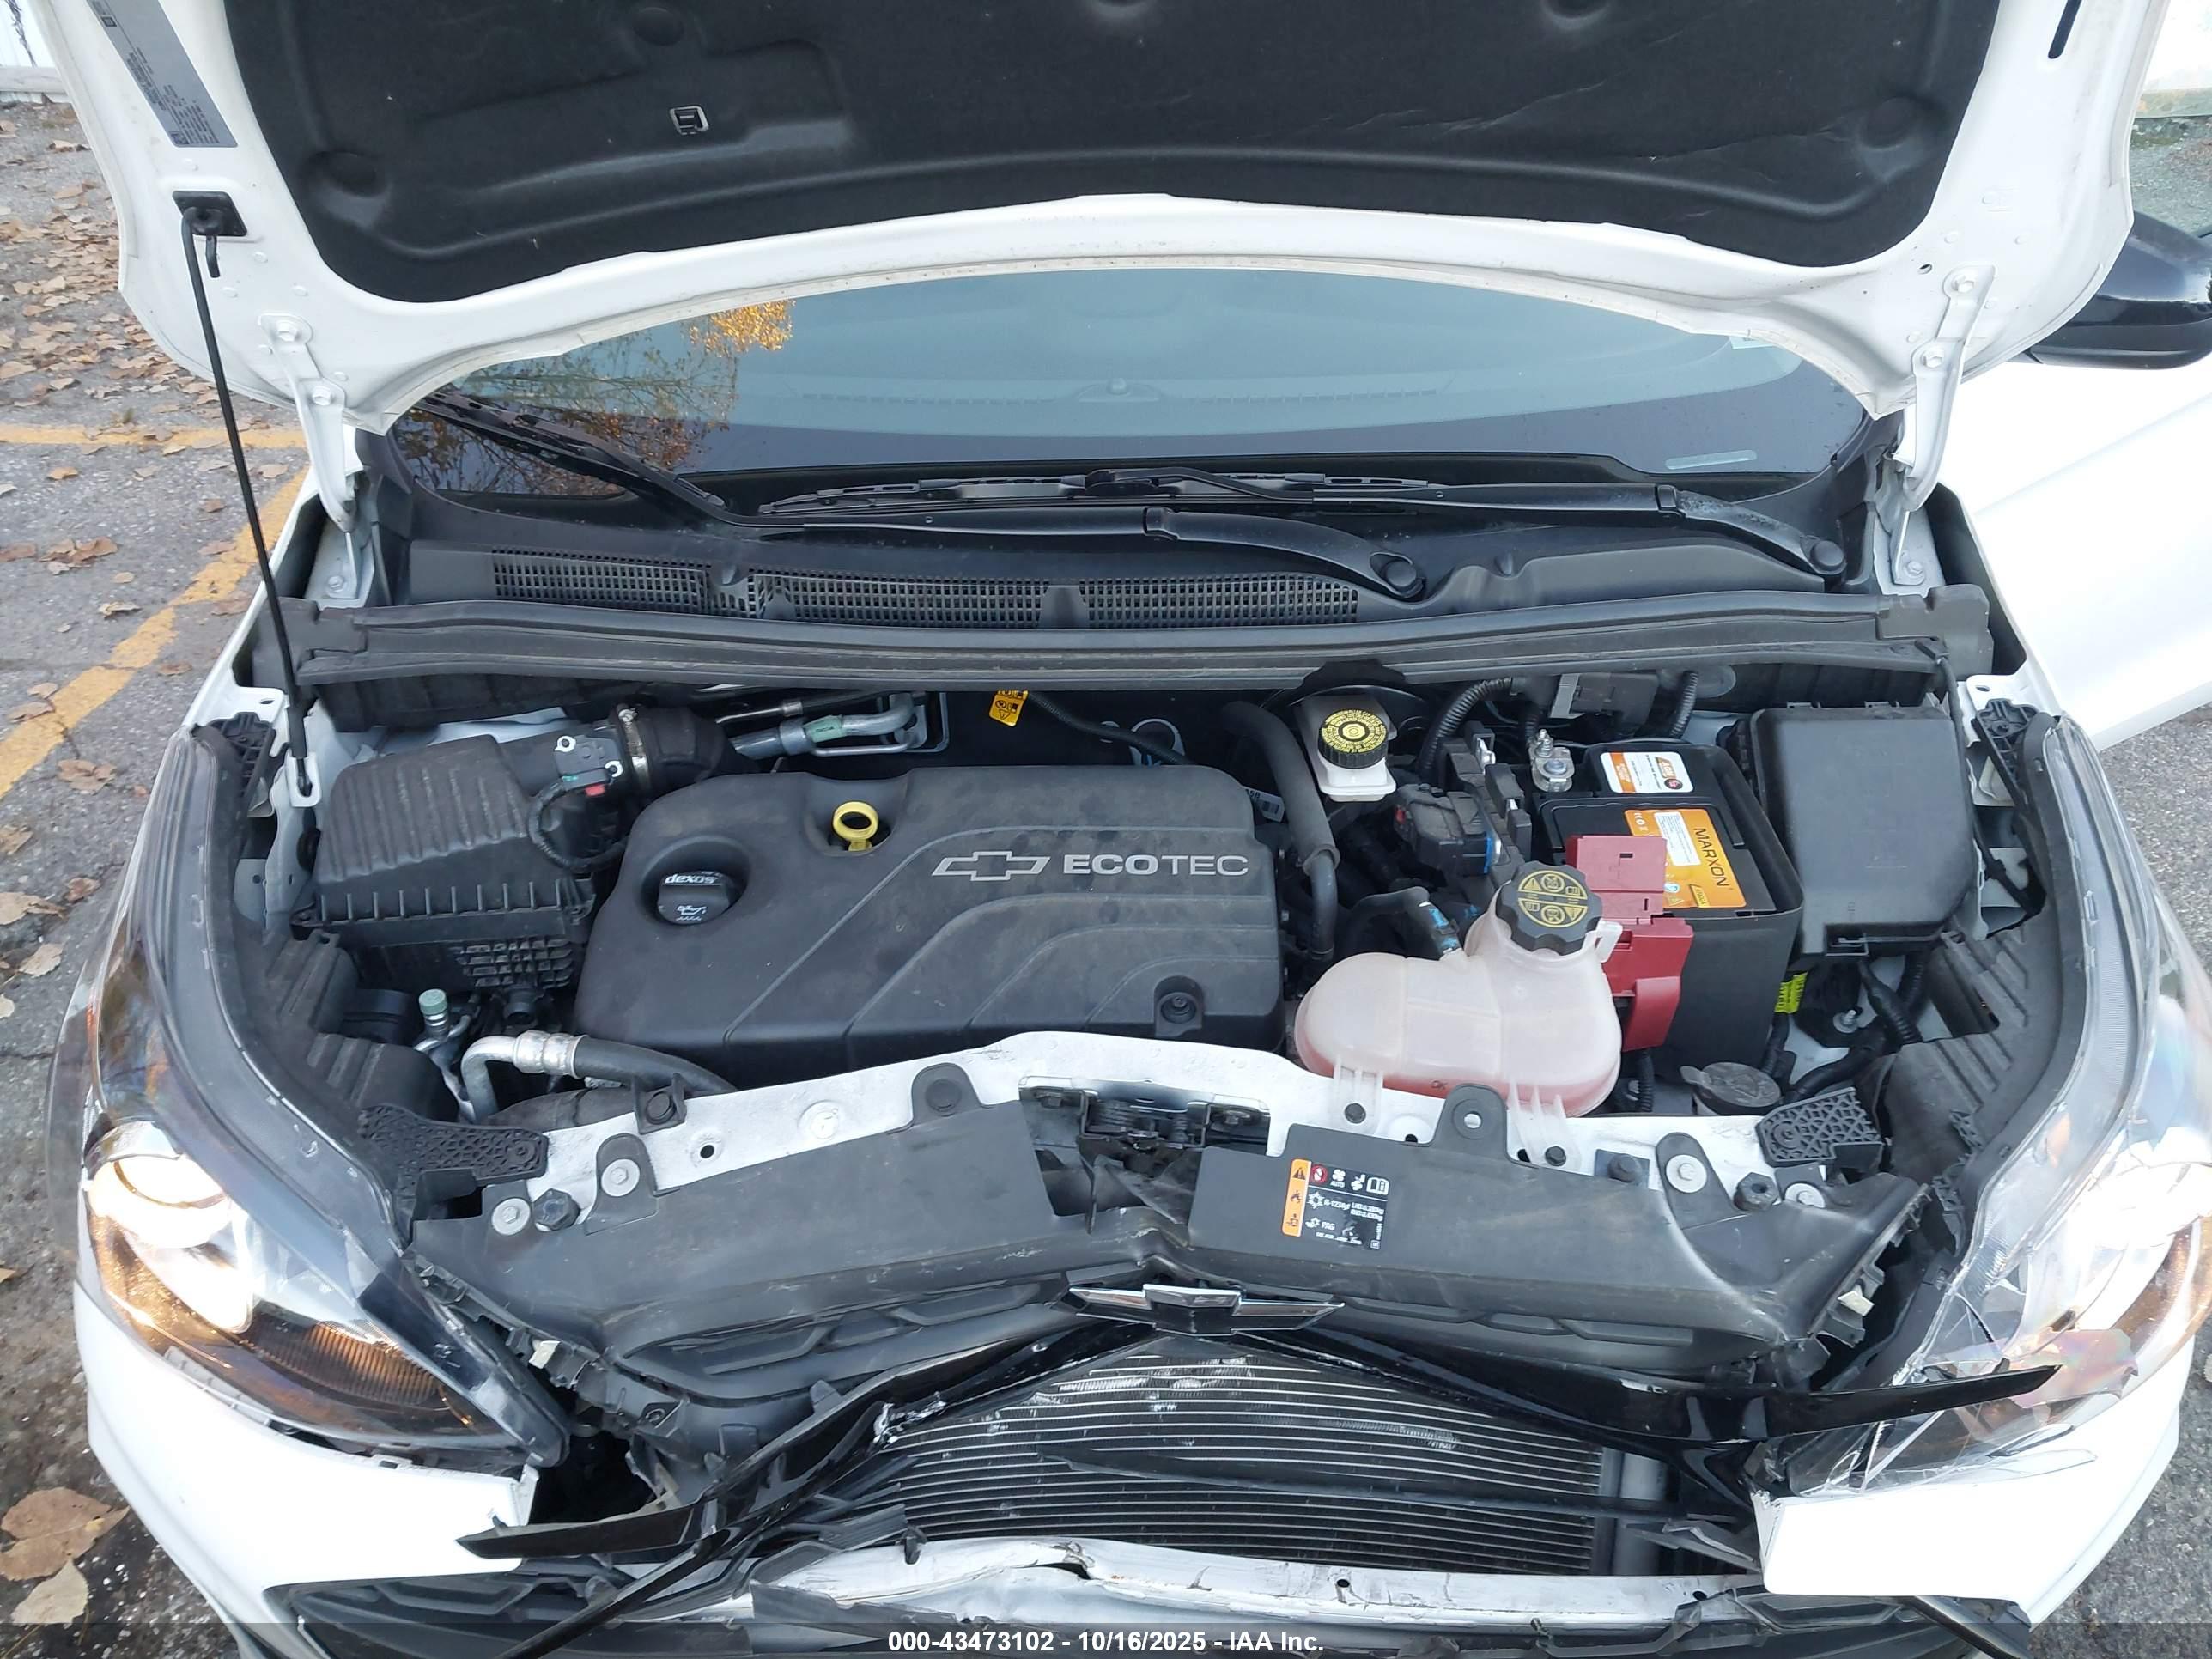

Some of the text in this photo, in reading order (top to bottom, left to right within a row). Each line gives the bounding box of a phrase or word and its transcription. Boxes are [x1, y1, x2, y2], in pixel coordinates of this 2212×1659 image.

[1063, 854, 1249, 876] ECOTEC
[1693, 828, 1729, 887] MARXON
[665, 873, 716, 884] dexos
